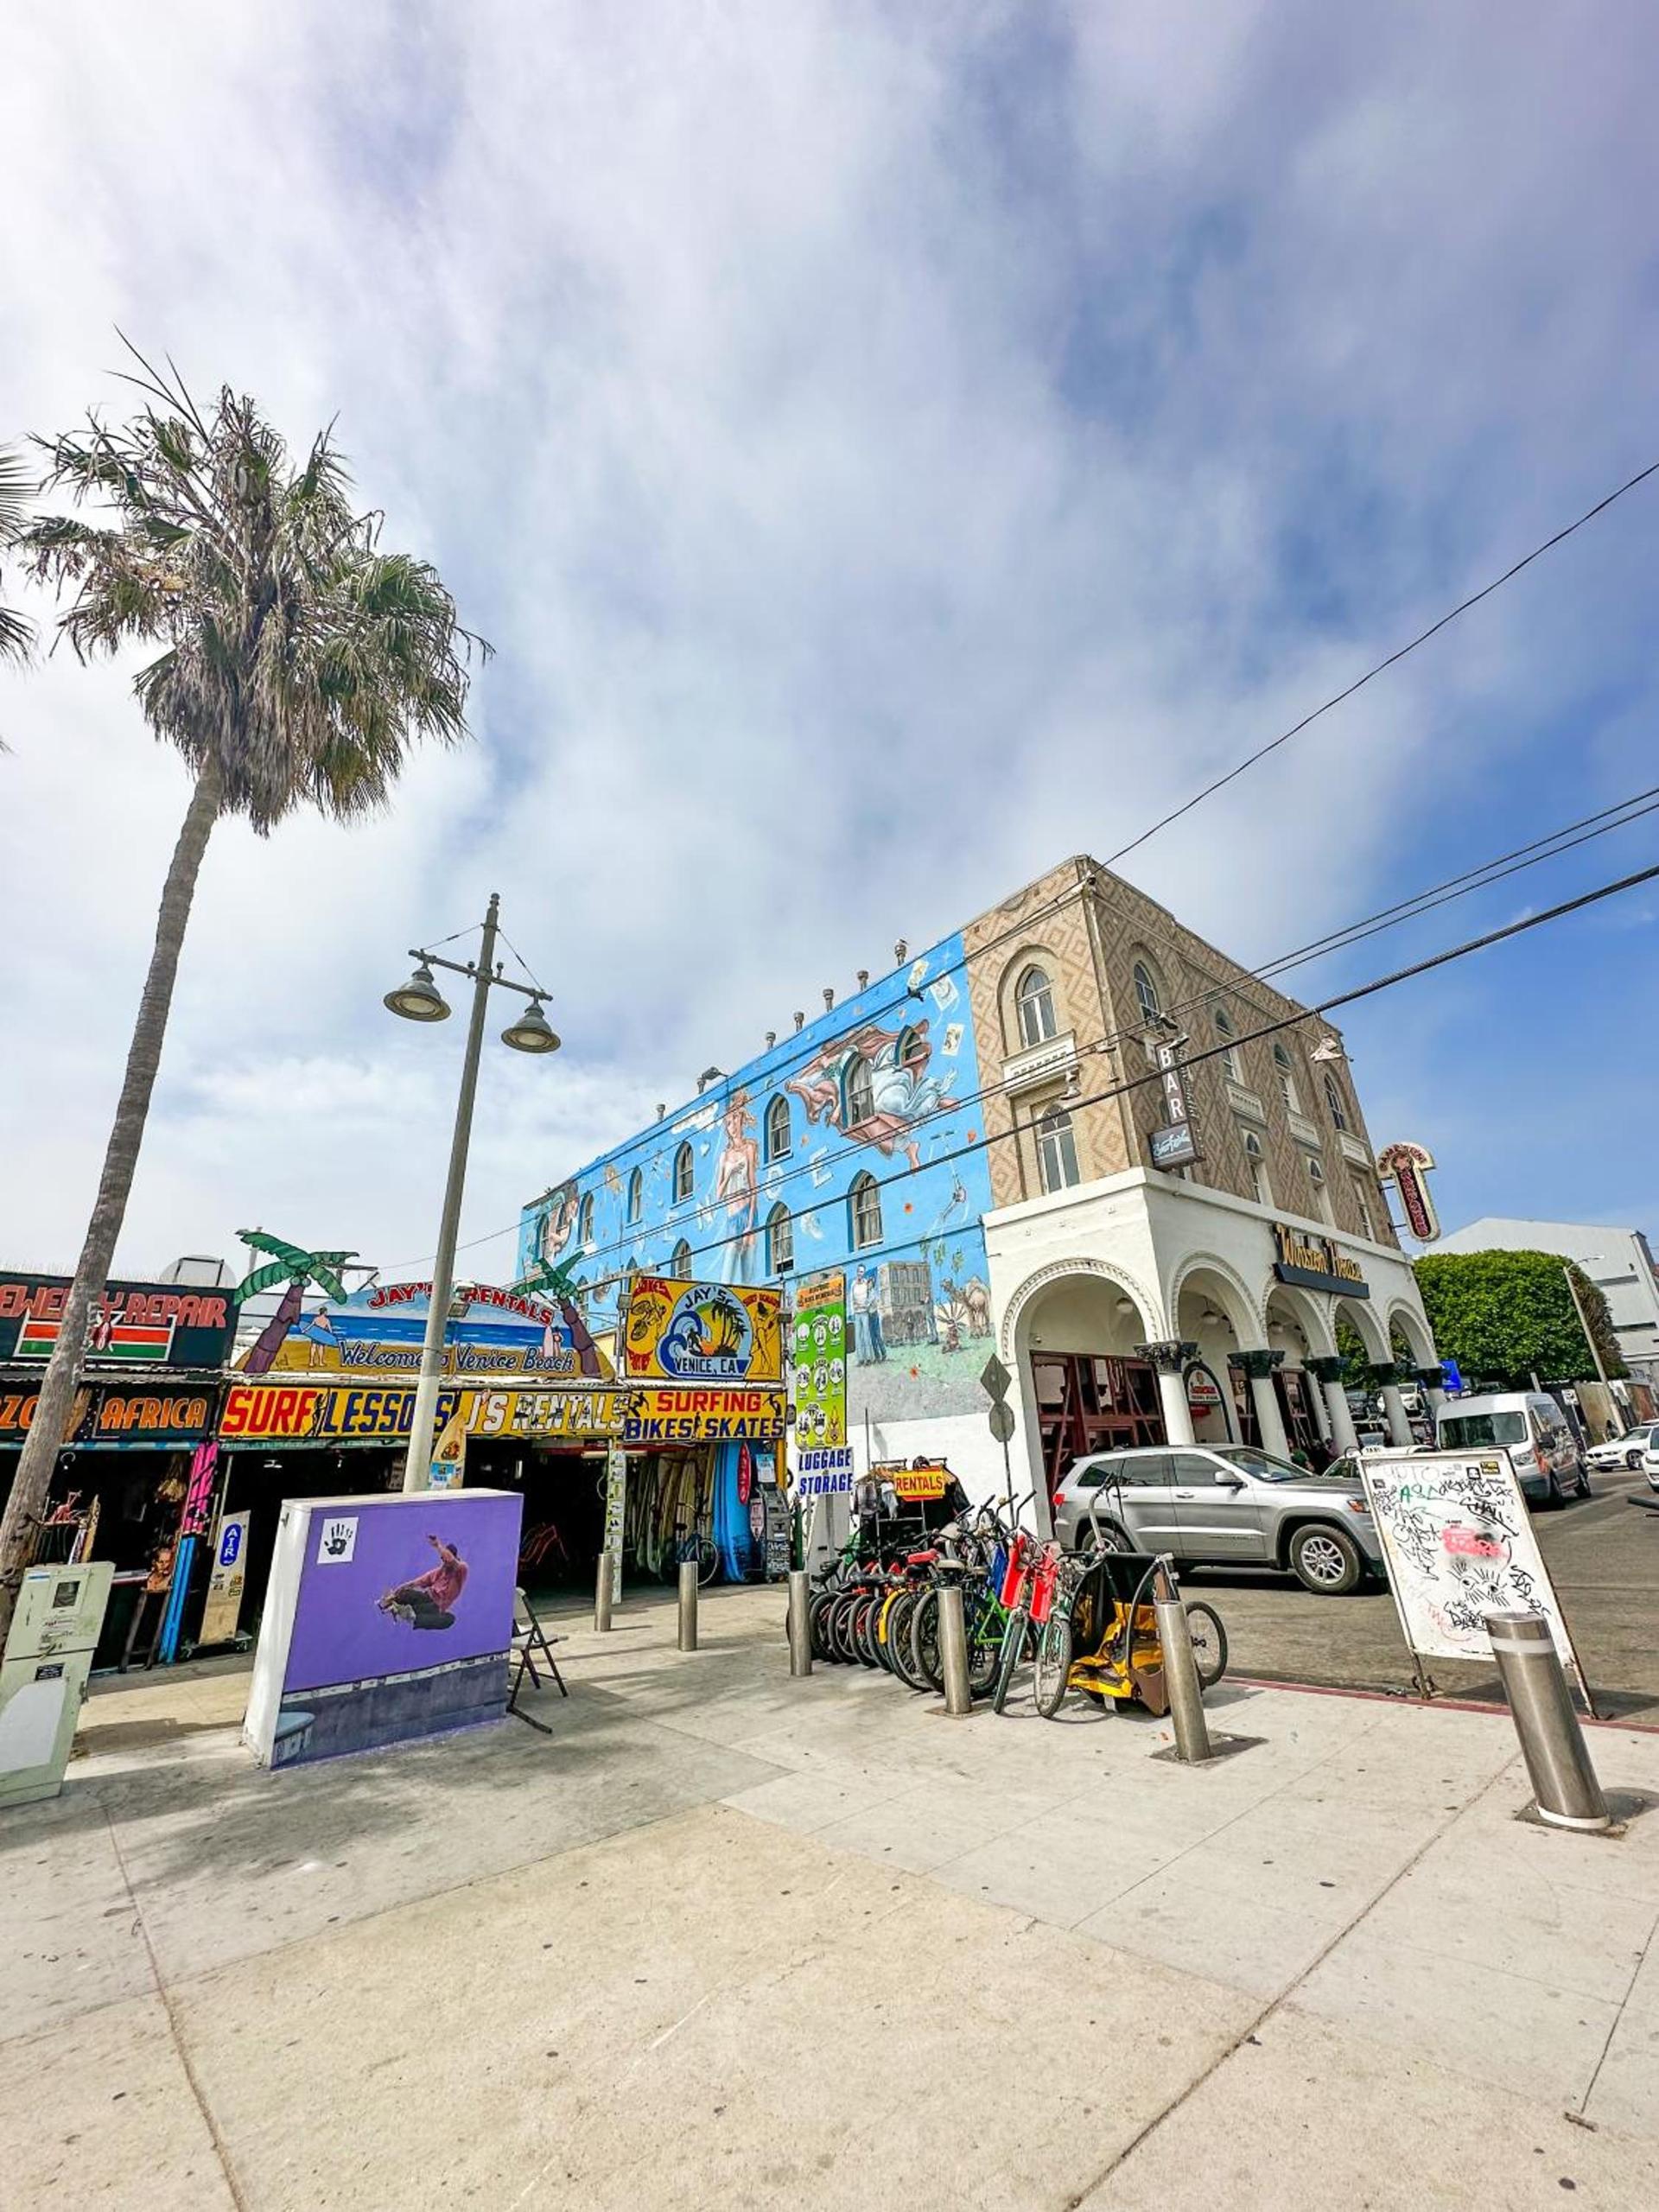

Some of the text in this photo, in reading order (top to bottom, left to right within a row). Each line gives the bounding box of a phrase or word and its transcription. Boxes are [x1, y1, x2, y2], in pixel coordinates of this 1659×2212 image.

[1160, 1047, 1184, 1119] BAR
[124, 1293, 227, 1328] REPAIR
[461, 1286, 554, 1326] RENTALS
[684, 1286, 728, 1310] JAY'S
[456, 1343, 517, 1370] Venice
[521, 1344, 574, 1373] Beach
[720, 1357, 737, 1374] CA
[99, 1397, 208, 1430] AFRICA
[221, 1389, 454, 1433] SURF LESSOS
[511, 1393, 628, 1431] RENTALS
[656, 1391, 761, 1413] SURFING
[625, 1417, 785, 1440] BIKES SKATES
[798, 1448, 852, 1471] LUGGAGE
[799, 1472, 854, 1496] STORAGE
[895, 1475, 944, 1492] RENTALS
[224, 1528, 238, 1558] AIR
